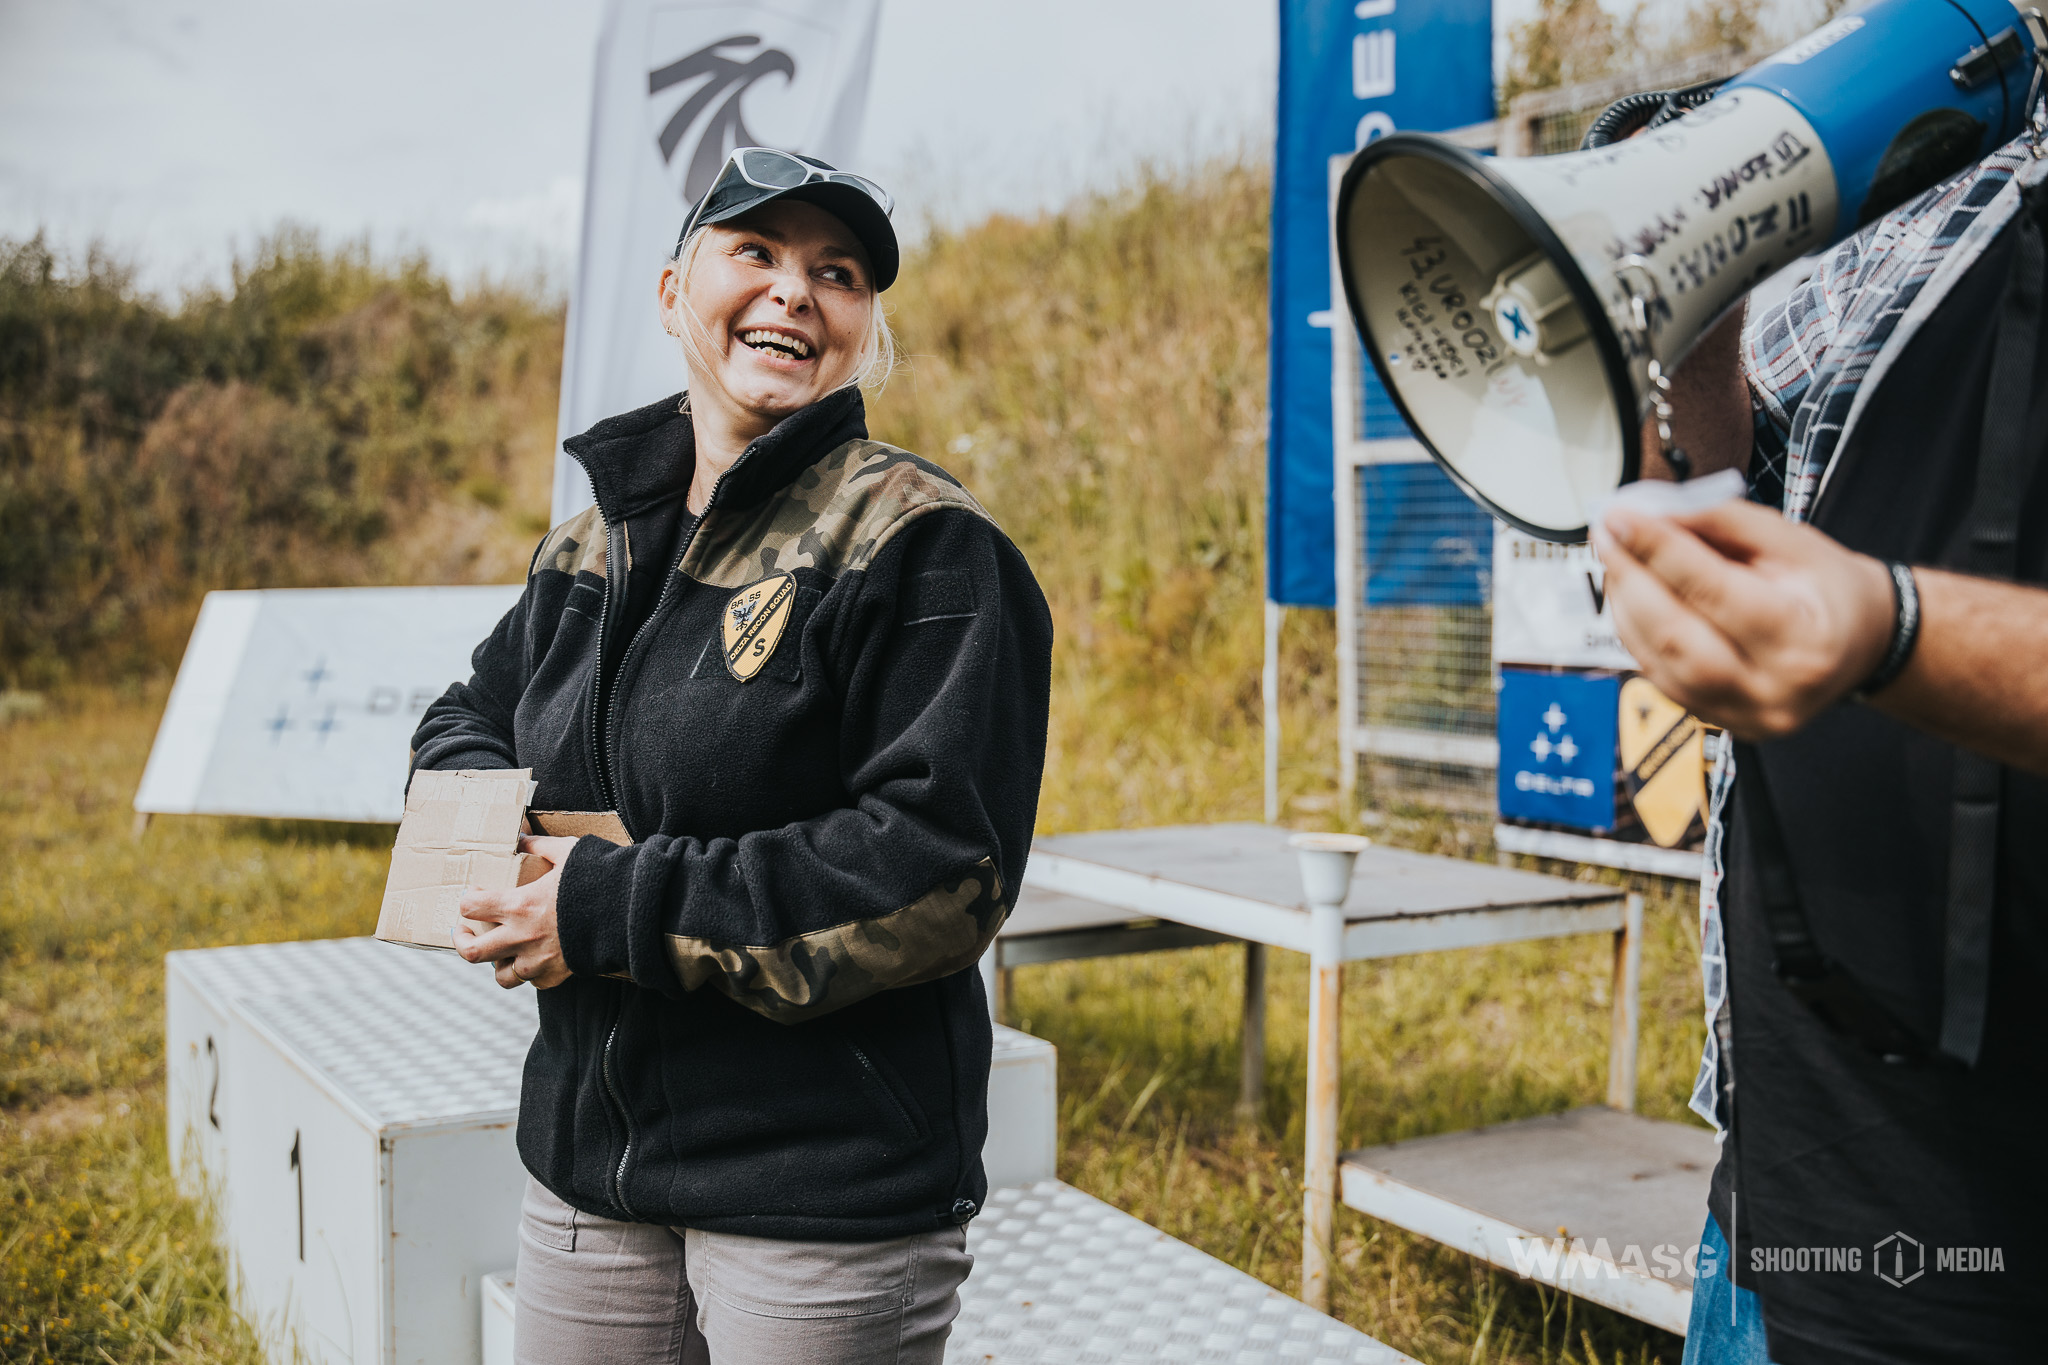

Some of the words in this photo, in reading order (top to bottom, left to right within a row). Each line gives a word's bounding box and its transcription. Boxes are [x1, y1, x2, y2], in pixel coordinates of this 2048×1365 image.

[729, 636, 750, 660] DELTA
[747, 609, 772, 637] RECON
[769, 582, 793, 610] SQUAD
[752, 637, 766, 657] S
